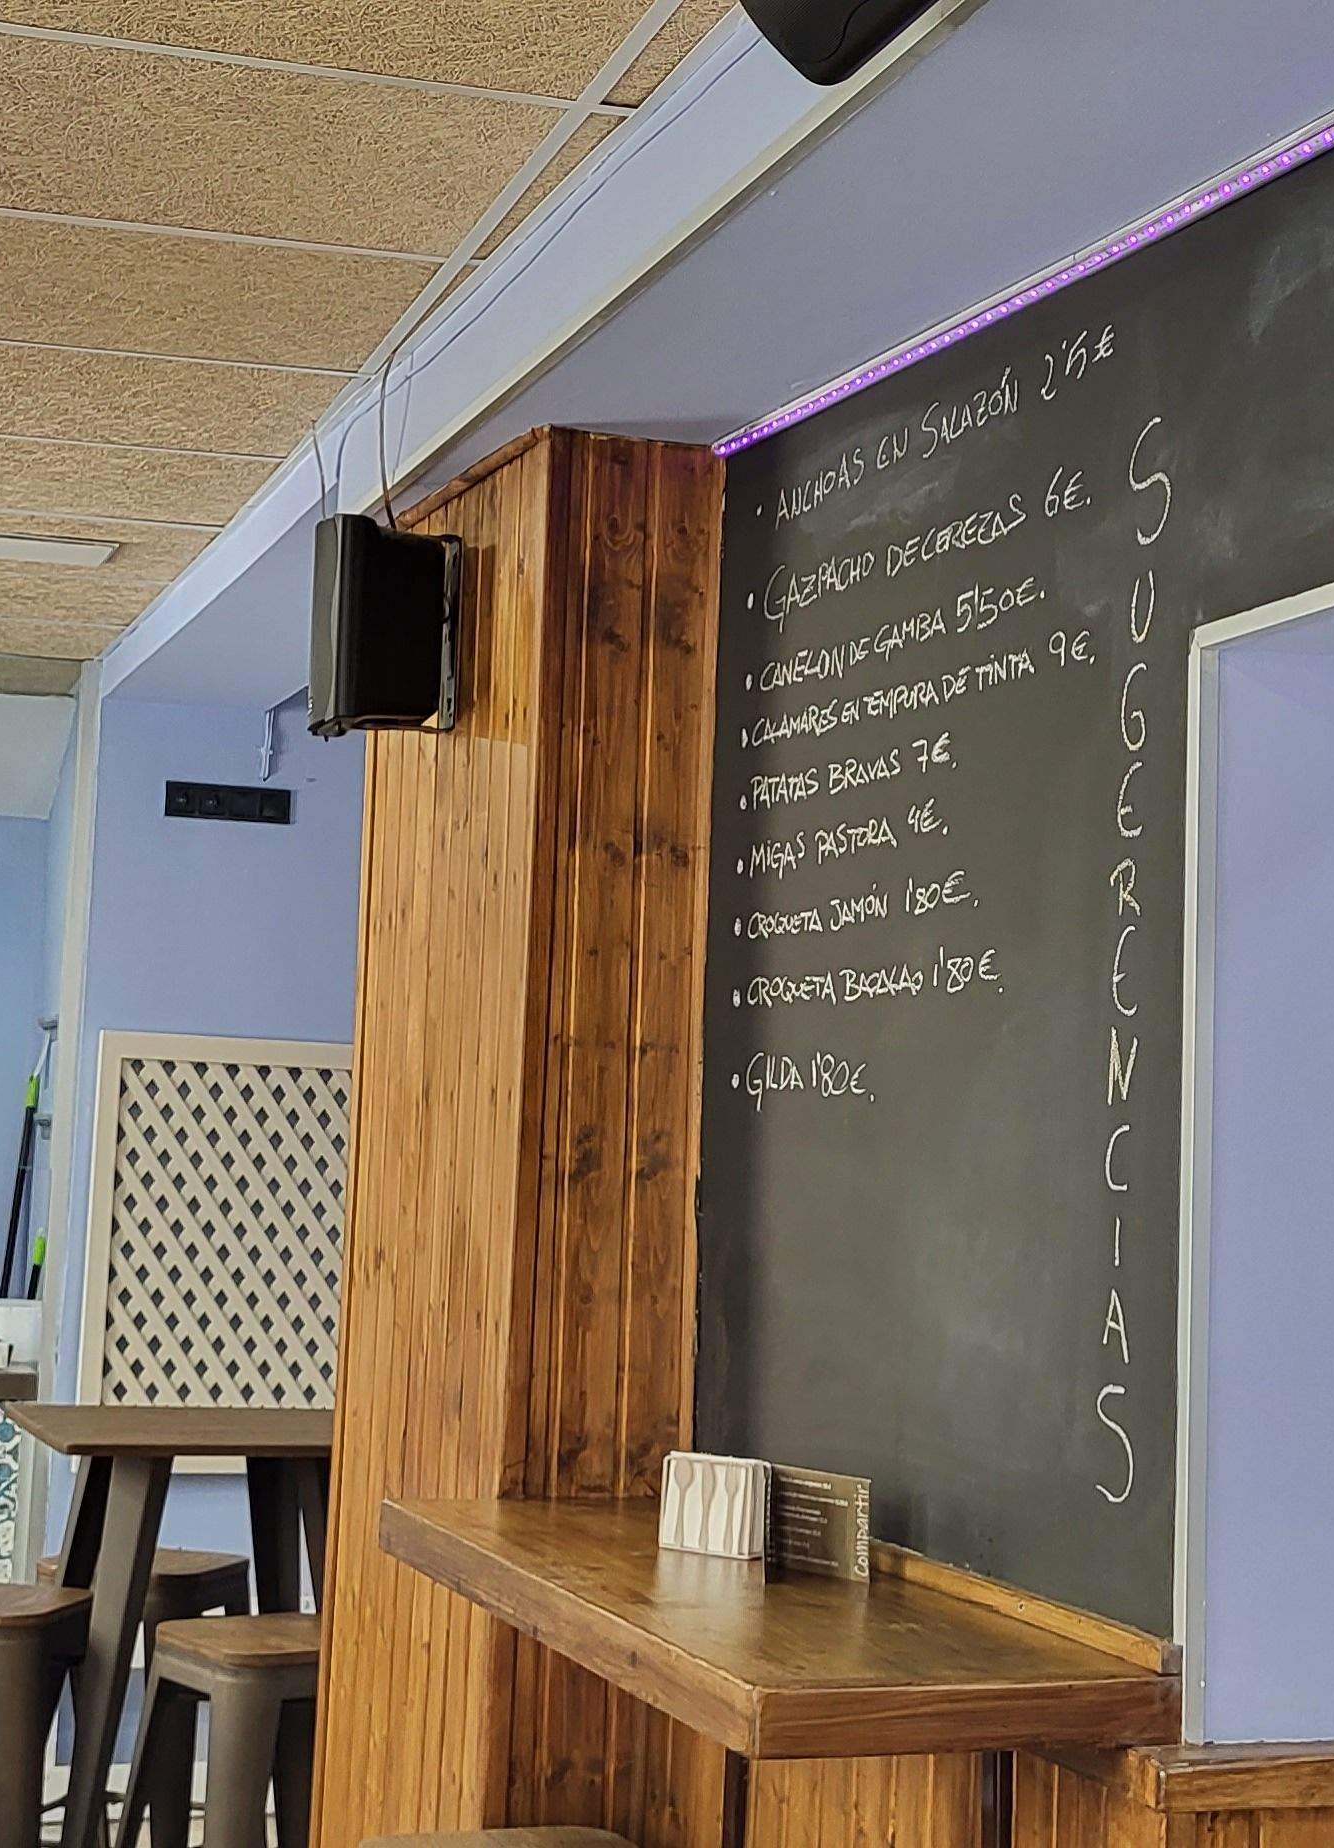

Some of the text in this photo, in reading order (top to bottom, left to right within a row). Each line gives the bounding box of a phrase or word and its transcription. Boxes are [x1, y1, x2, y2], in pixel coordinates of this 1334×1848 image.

[774, 448, 865, 530] ANCHOAS
[876, 429, 909, 469] EN
[764, 550, 877, 634] GAZPACHO
[759, 646, 845, 692] CANELON
[849, 637, 871, 667] DE
[873, 608, 947, 661] GAMBA
[750, 699, 839, 748] CALAMARES
[841, 703, 861, 725] EN
[863, 679, 940, 719] TEMPURA
[942, 666, 970, 698] DE
[750, 767, 820, 810] PATATAS
[827, 748, 902, 796] BRAVAS
[815, 818, 898, 865] PASTORA
[747, 907, 824, 940] CROQUETA
[747, 974, 837, 1008] CROQUETA
[839, 964, 924, 1002] BACALAO
[1094, 416, 1172, 1504] SUGERENCIAS
[745, 1051, 805, 1112] GILDA
